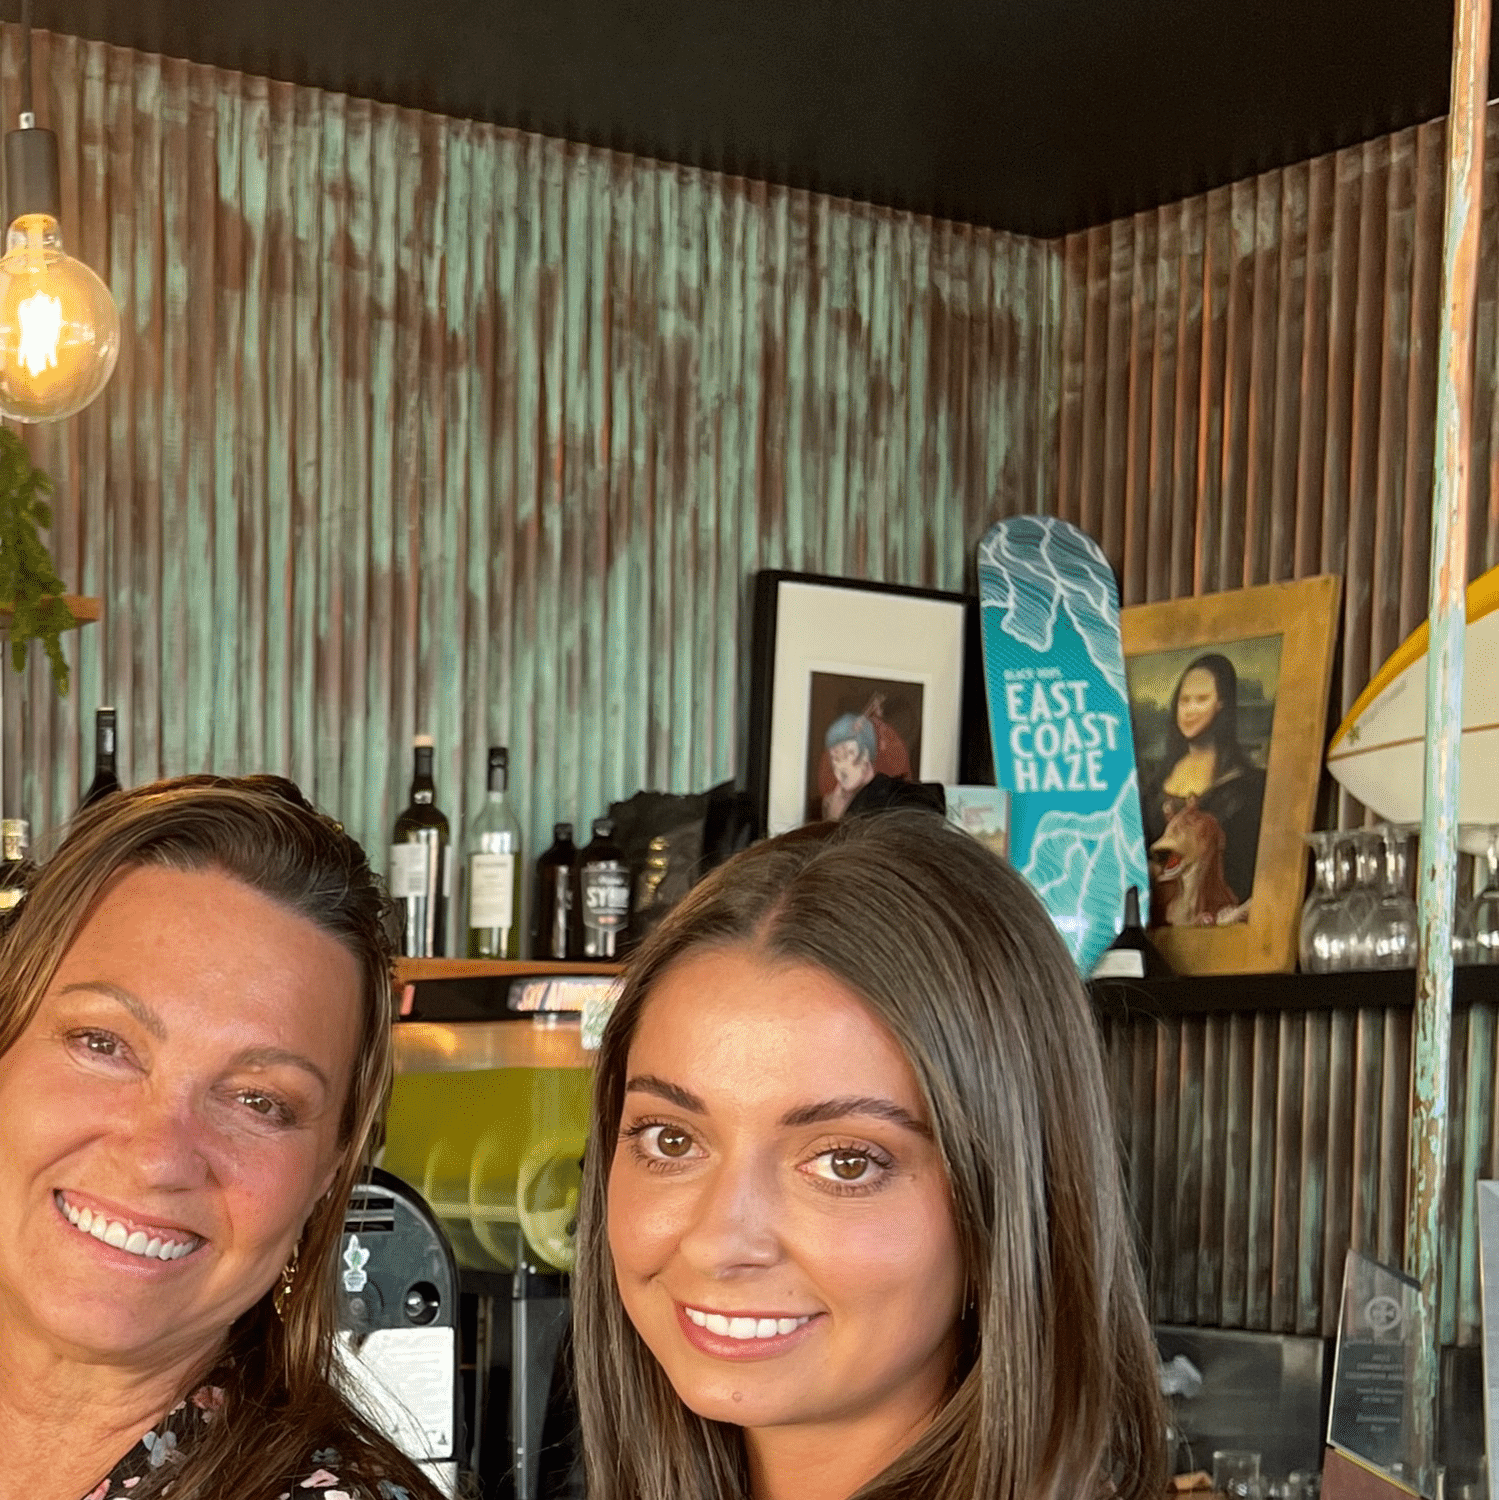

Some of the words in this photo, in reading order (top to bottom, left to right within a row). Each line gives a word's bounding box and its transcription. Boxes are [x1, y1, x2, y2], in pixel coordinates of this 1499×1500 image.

[1006, 680, 1090, 723] EAST
[1010, 712, 1120, 759] COAST
[1014, 750, 1108, 793] HAZE
